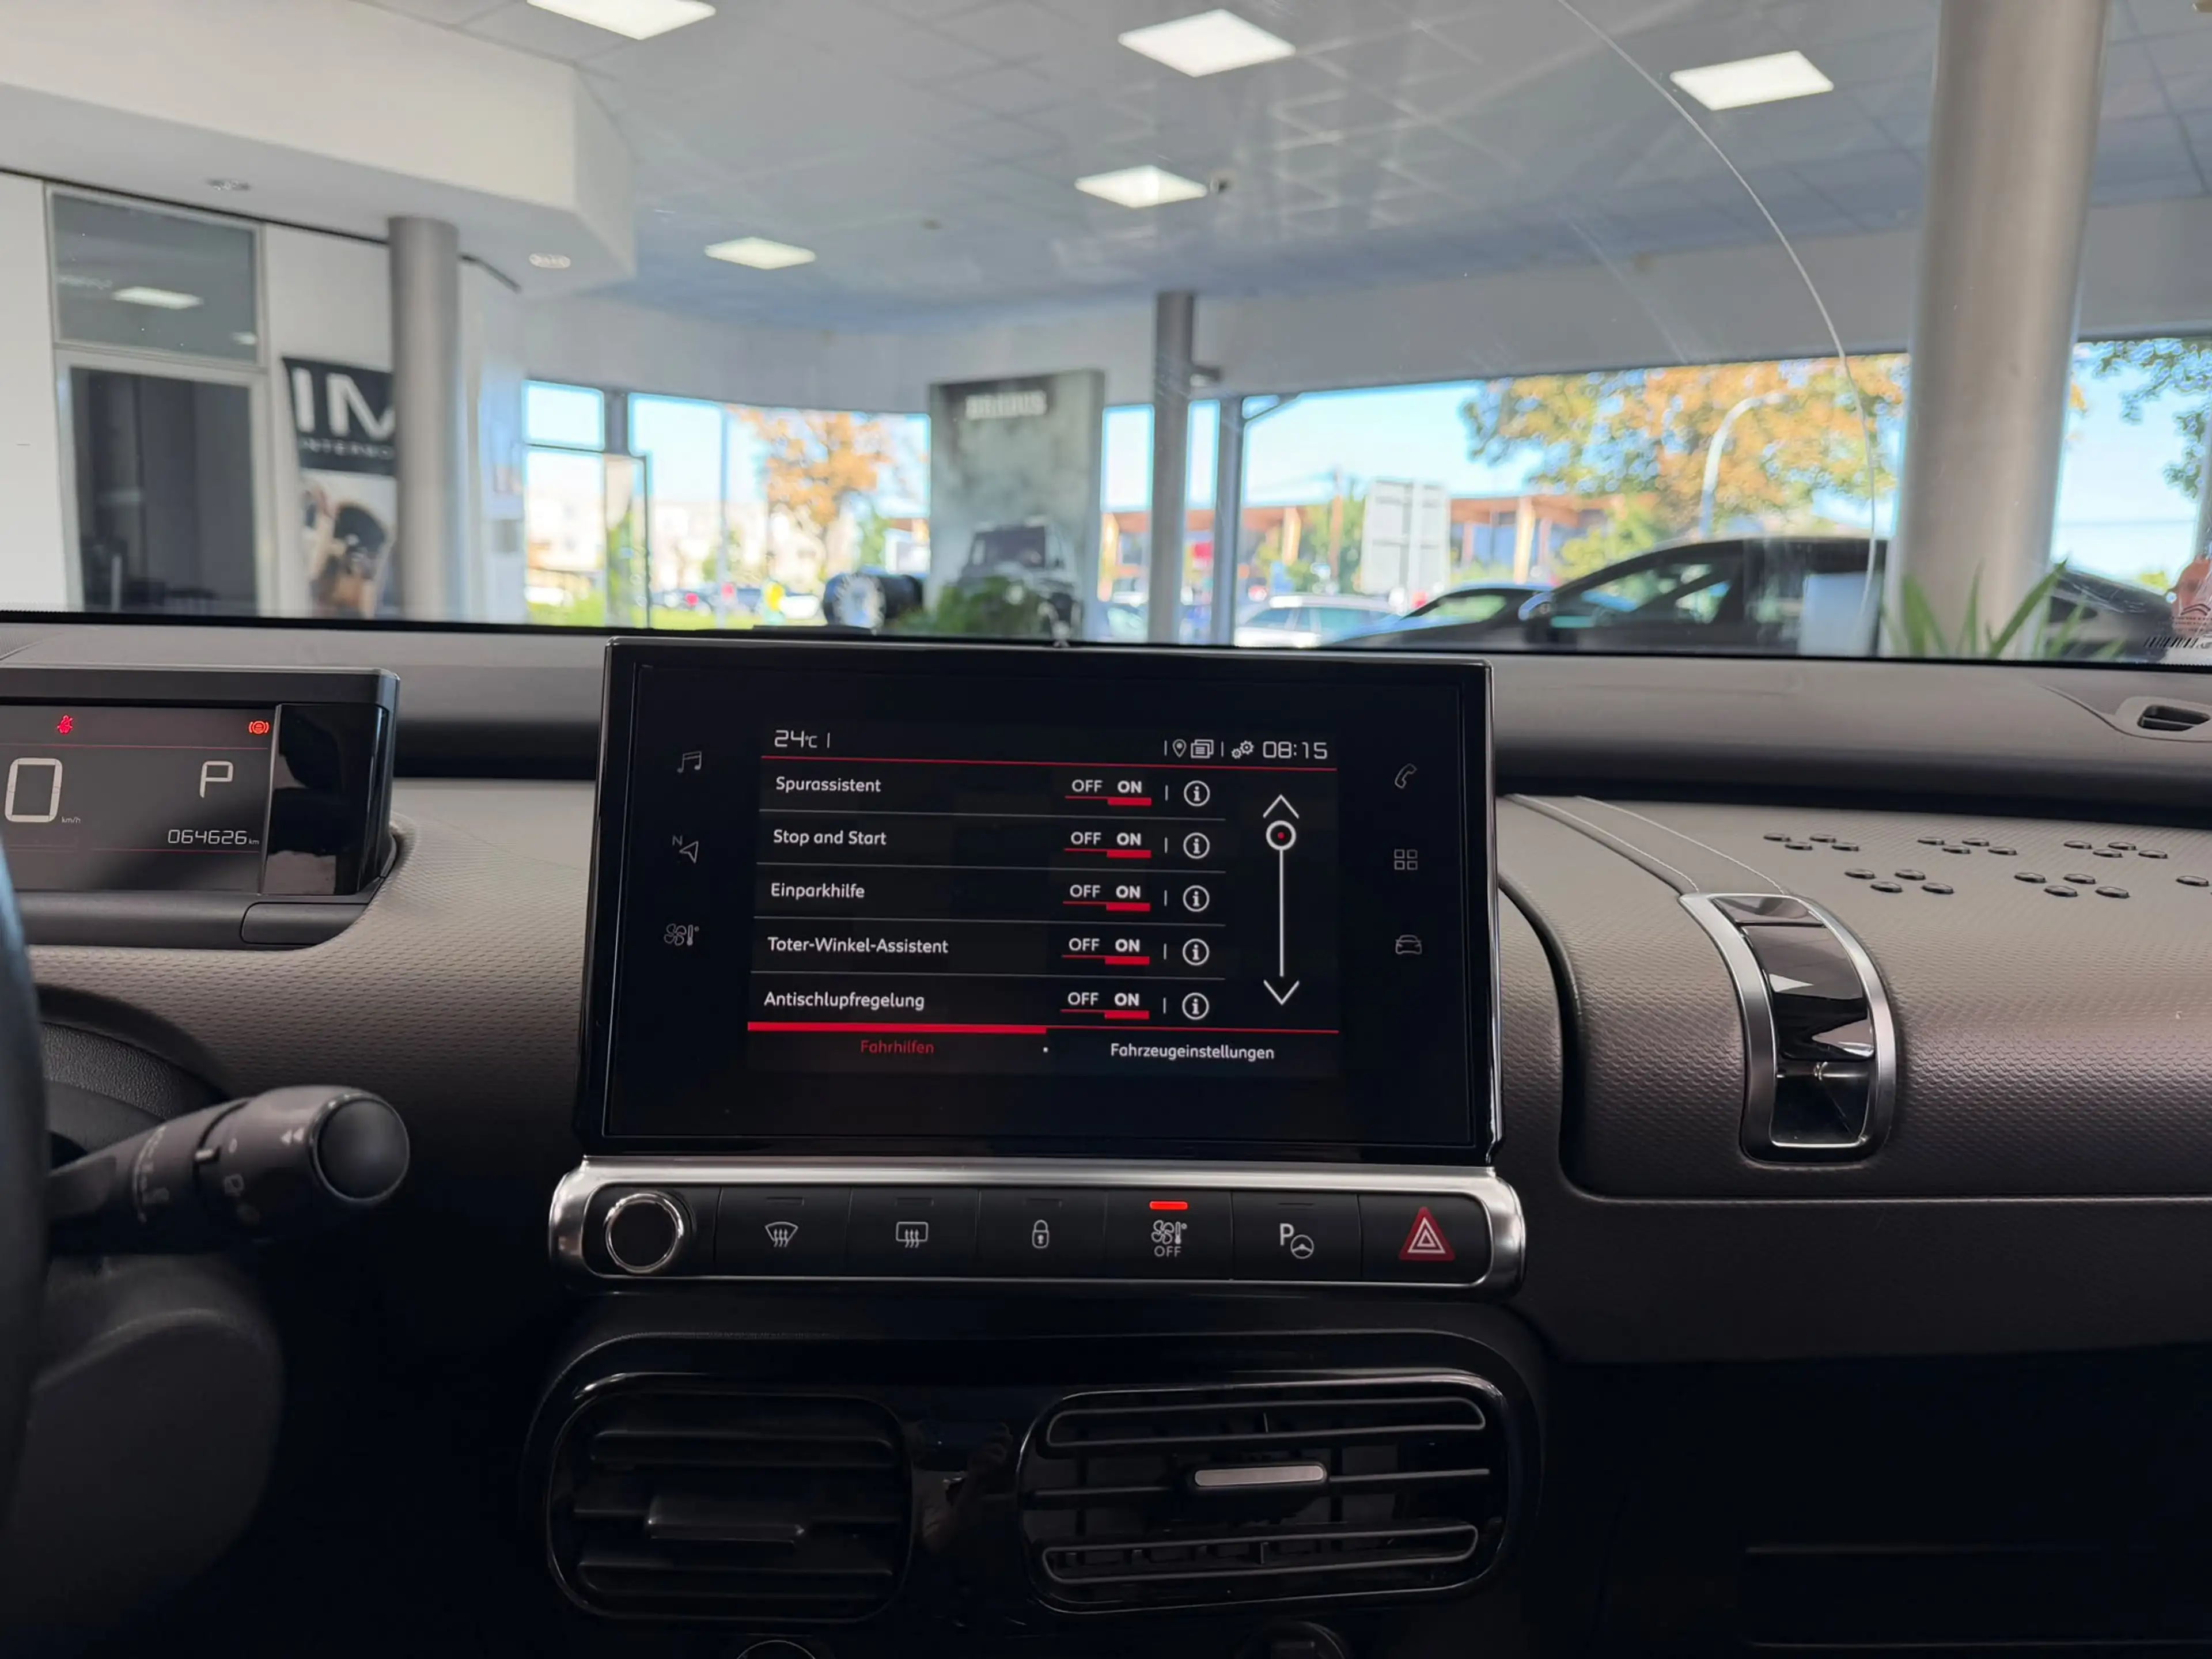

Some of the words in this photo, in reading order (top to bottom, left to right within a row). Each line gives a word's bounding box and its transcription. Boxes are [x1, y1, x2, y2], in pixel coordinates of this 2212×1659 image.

[1263, 741, 1328, 759] 08:15
[199, 760, 233, 798] P
[776, 776, 881, 793] Spurassistent
[1071, 779, 1103, 793] OFF
[1117, 781, 1142, 793] ON
[5, 757, 63, 823] 0
[61, 816, 81, 824] km/h
[168, 829, 247, 844] 064626
[773, 829, 810, 846] Stop
[813, 830, 844, 844] and
[848, 831, 887, 845] Start
[1070, 832, 1101, 845] OFF
[1116, 833, 1141, 846] ON
[771, 882, 865, 900] Einparkhilfe
[1070, 885, 1101, 897] OFF
[1116, 886, 1141, 899] ON
[767, 937, 949, 953] Toter-Winkel-Assistent
[1069, 938, 1100, 951] OFF
[1115, 939, 1140, 952] ON
[764, 991, 925, 1011] Antischlupfregelung
[1067, 992, 1099, 1005] OFF
[1114, 993, 1139, 1006] ON
[861, 1040, 934, 1054] Fahrhilfen
[1110, 1043, 1275, 1062] Fahrzeugeinstellungen
[1154, 1245, 1181, 1257] OFF
